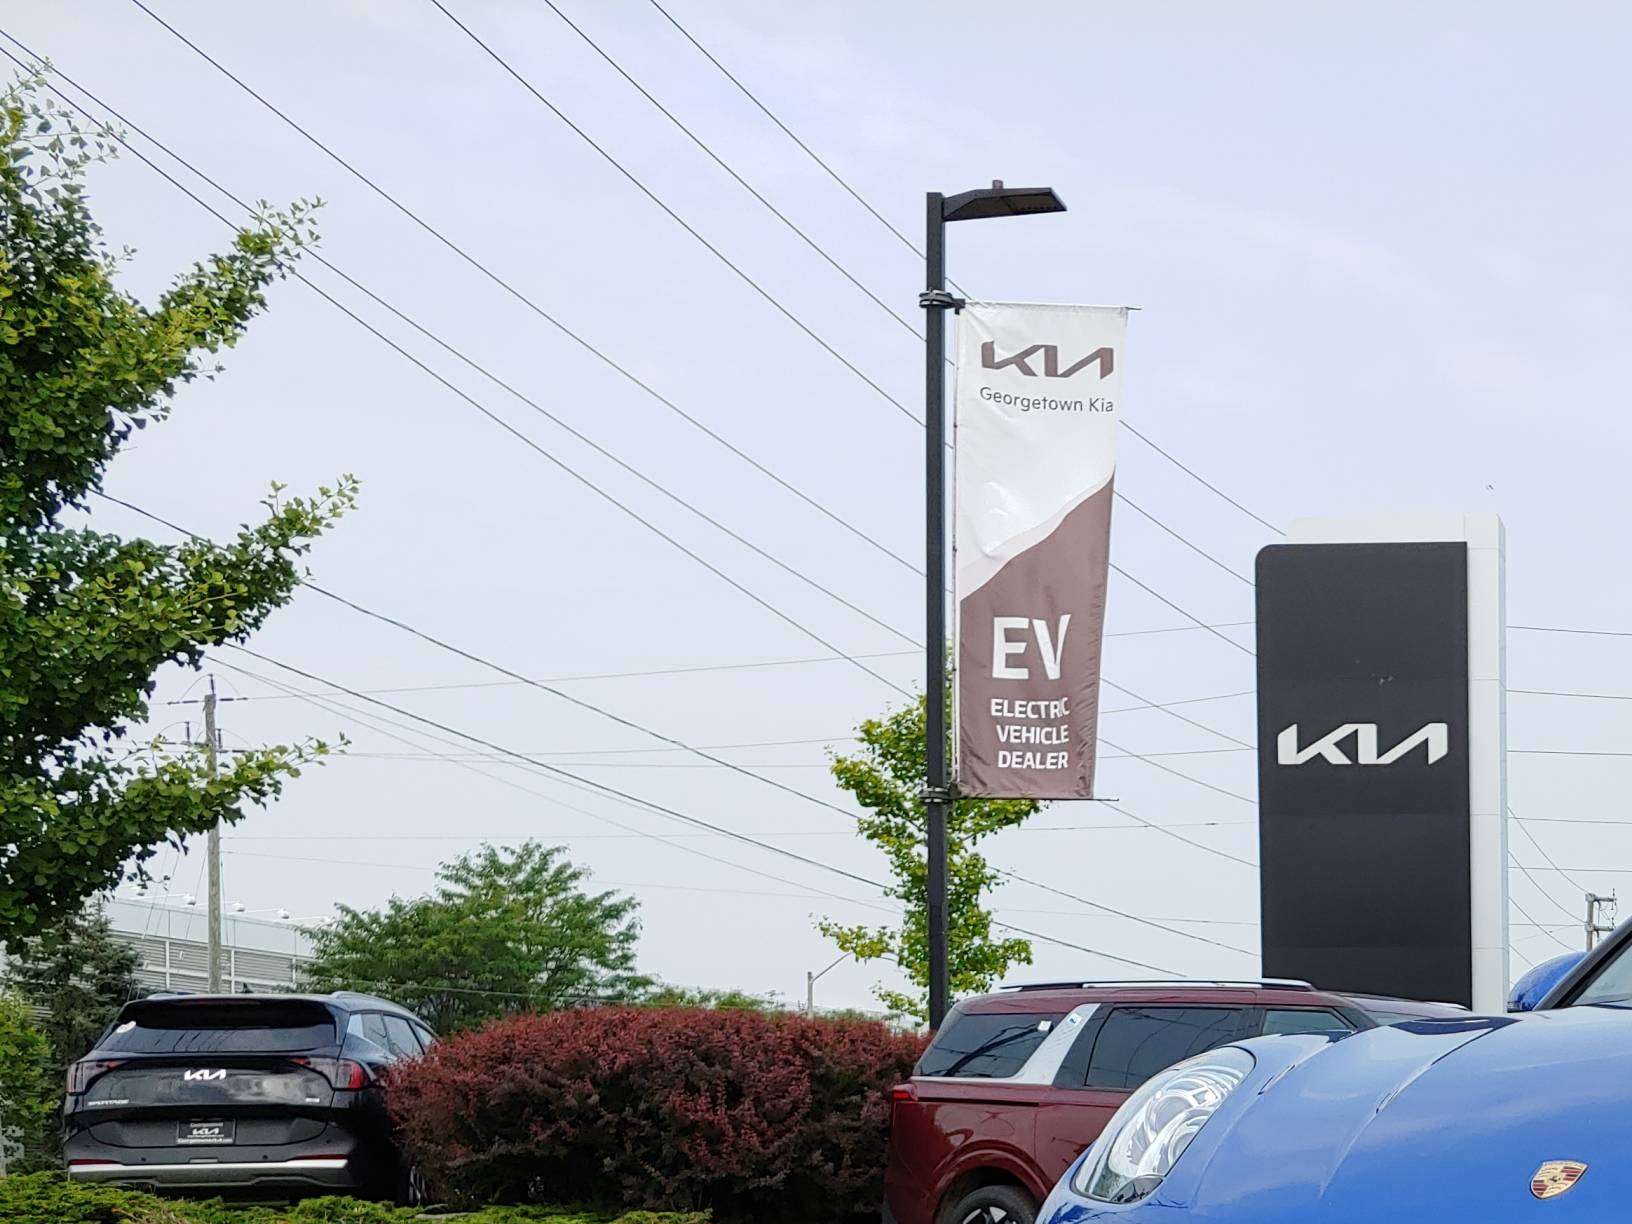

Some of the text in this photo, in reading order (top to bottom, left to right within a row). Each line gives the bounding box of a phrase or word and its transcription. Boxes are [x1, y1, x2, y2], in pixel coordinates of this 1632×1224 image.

[981, 341, 1114, 379] KIA
[980, 387, 1113, 412] Georgetown Kia
[992, 614, 1072, 680] EV
[996, 724, 1069, 745] VEHICLE
[1277, 722, 1449, 766] KIA
[997, 750, 1069, 769] DEALER
[184, 1069, 227, 1080] KIA
